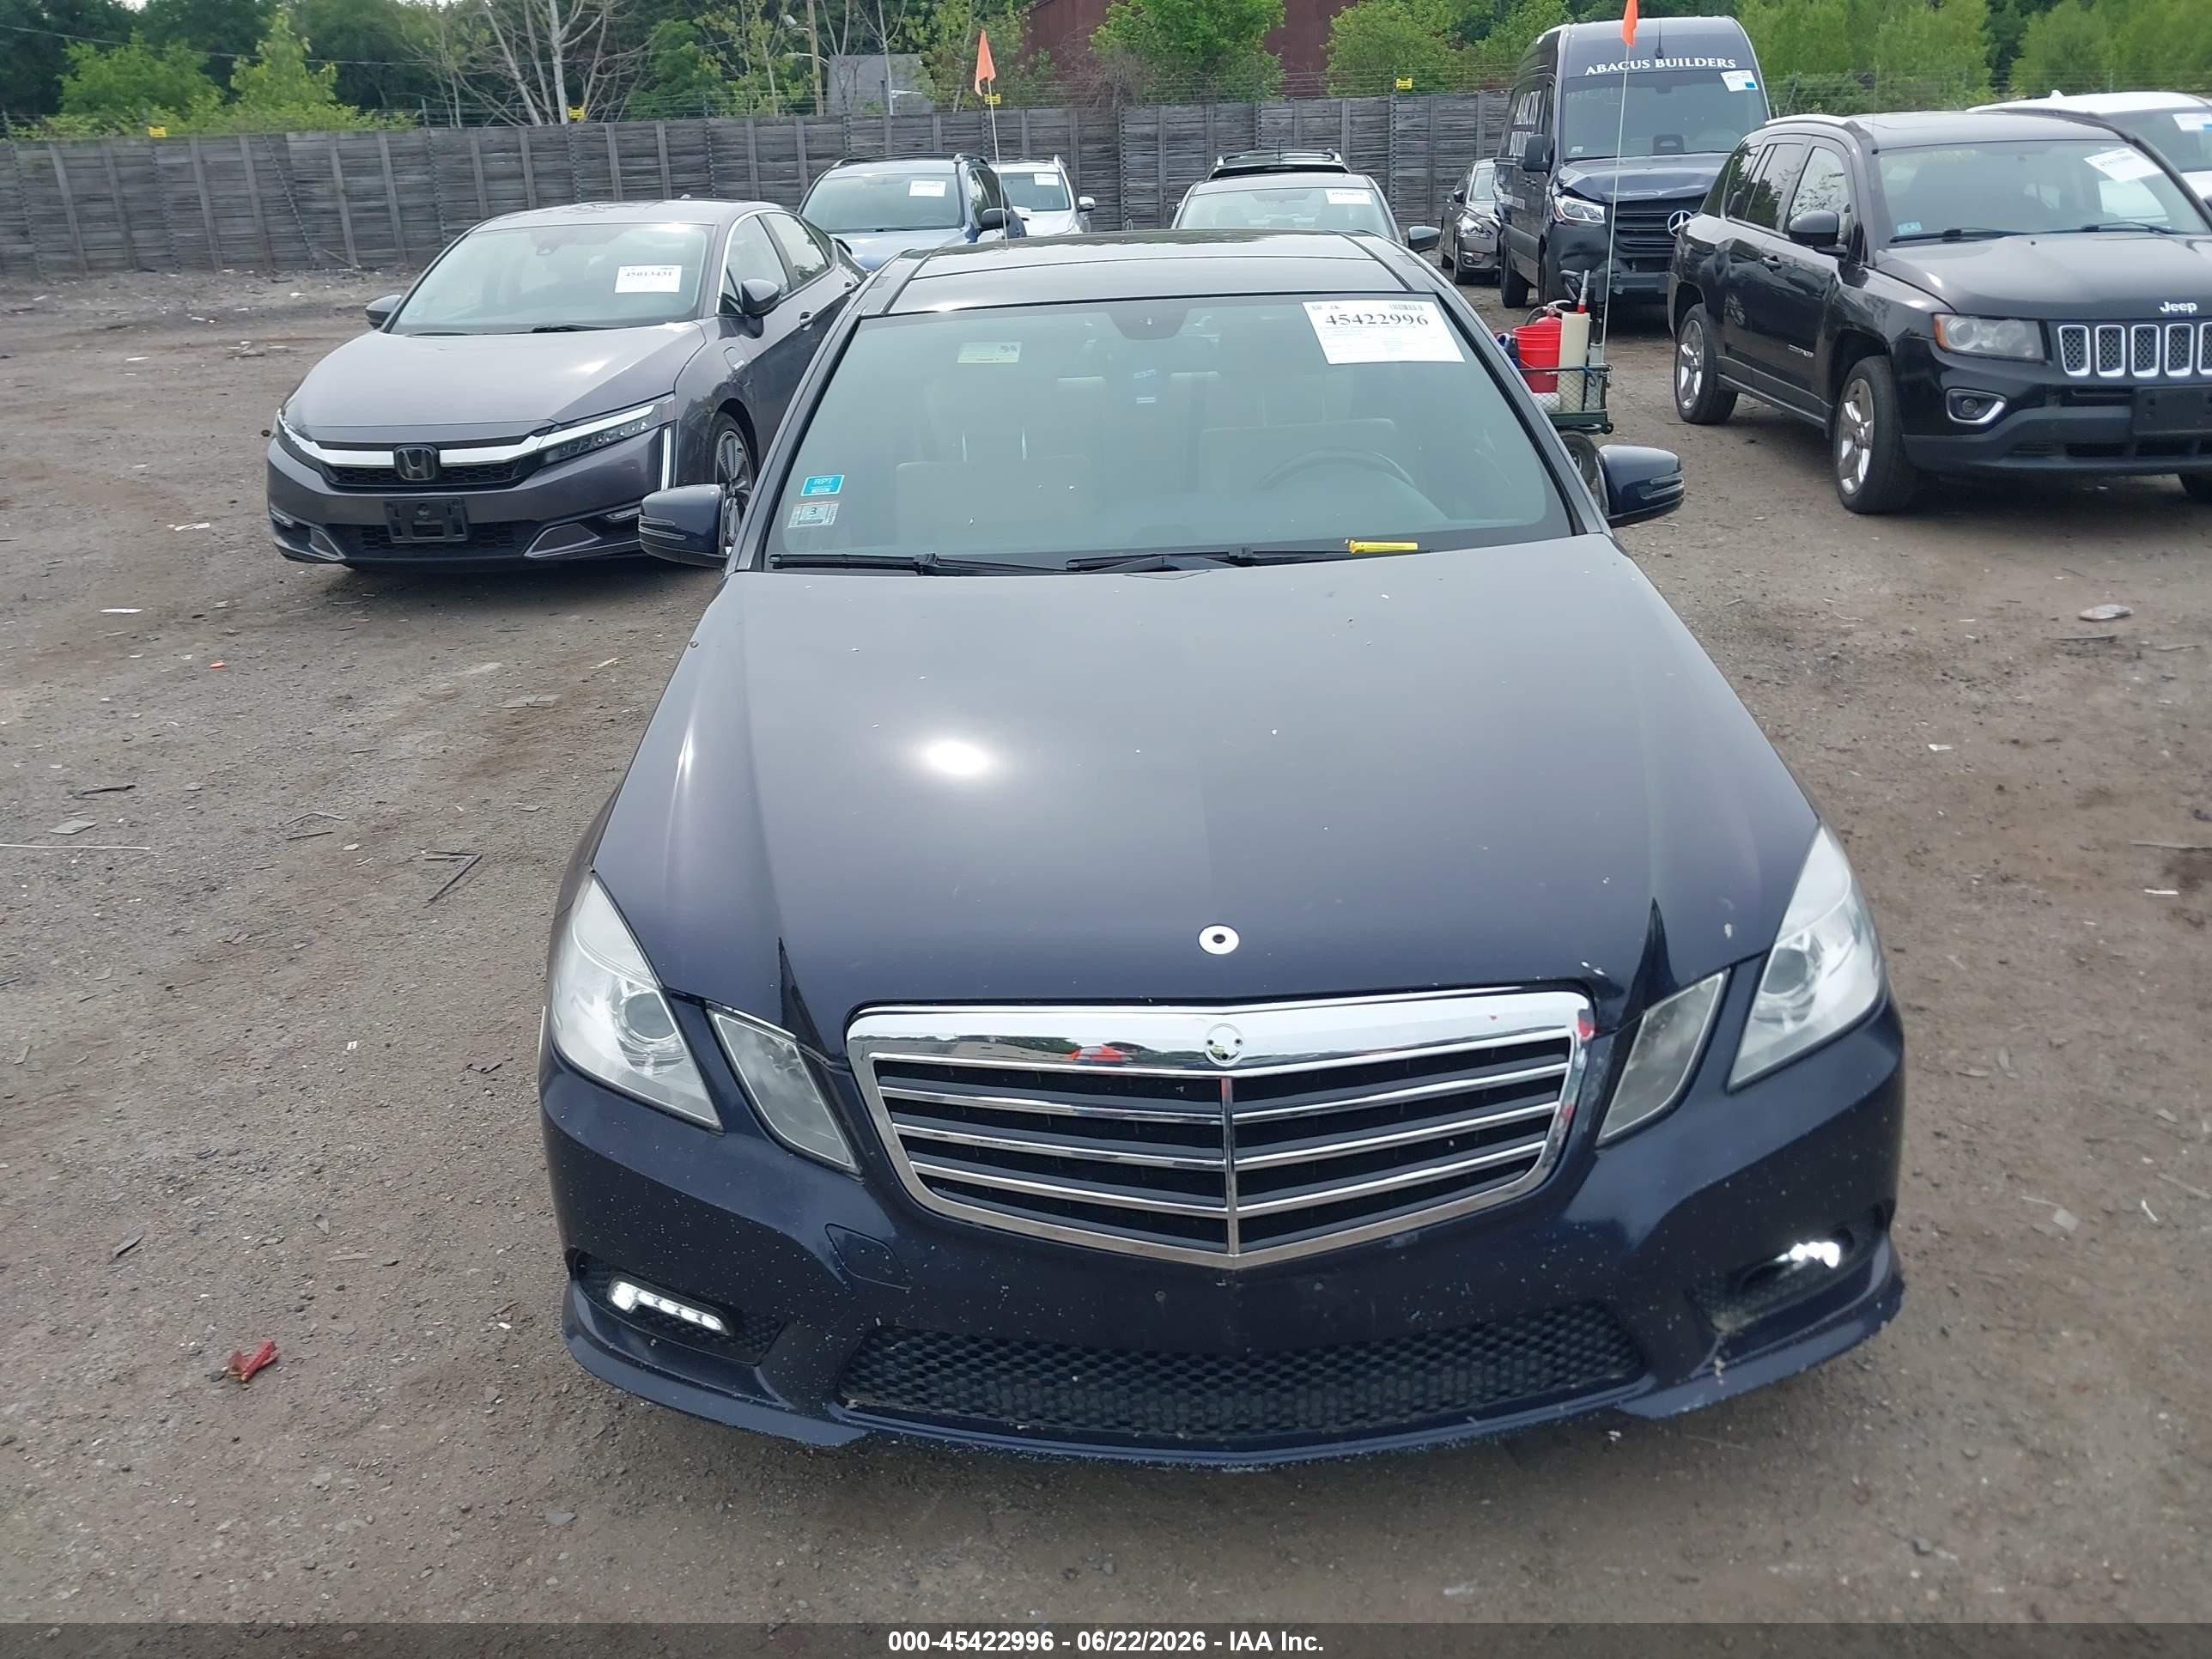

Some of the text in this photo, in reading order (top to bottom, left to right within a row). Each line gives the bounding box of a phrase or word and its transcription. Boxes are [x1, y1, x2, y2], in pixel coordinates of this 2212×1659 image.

[1585, 58, 1736, 76] ABACUS BUILDERS
[2159, 301, 2197, 313] Jeep
[1325, 313, 1429, 325] 45422996
